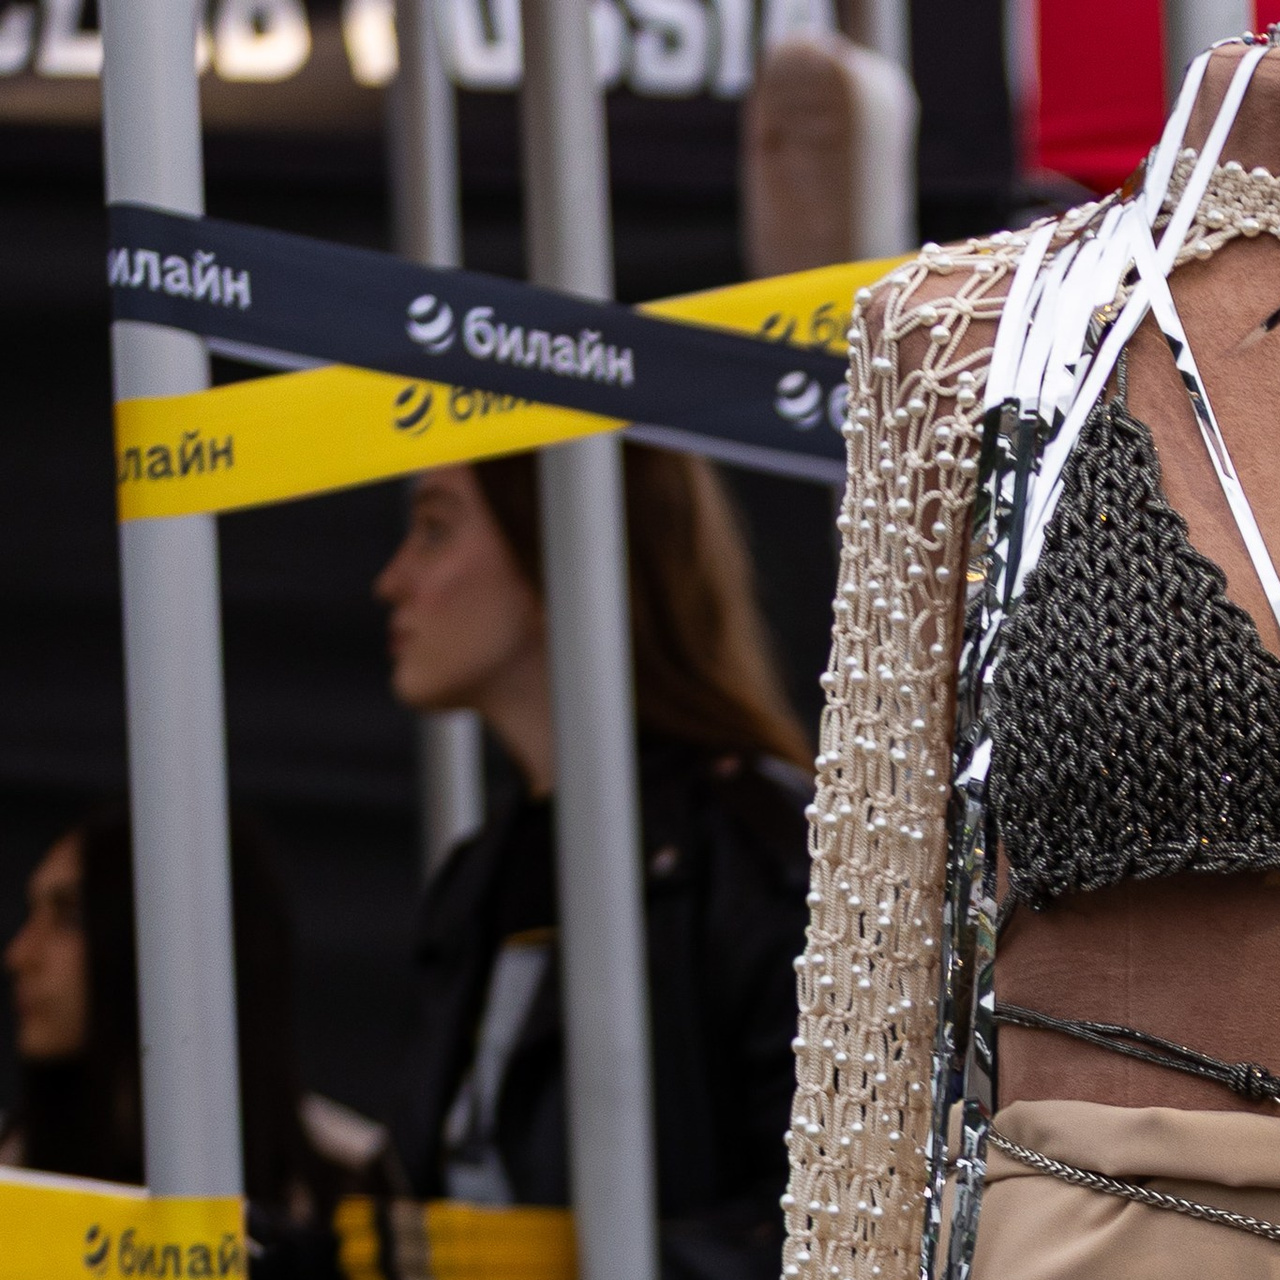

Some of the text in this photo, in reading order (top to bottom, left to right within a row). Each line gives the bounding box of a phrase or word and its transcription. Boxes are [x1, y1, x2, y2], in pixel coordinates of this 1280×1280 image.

[107, 247, 252, 310] илайн
[462, 305, 636, 388] билайн
[117, 430, 235, 483] лайн
[117, 1226, 246, 1280] билай
